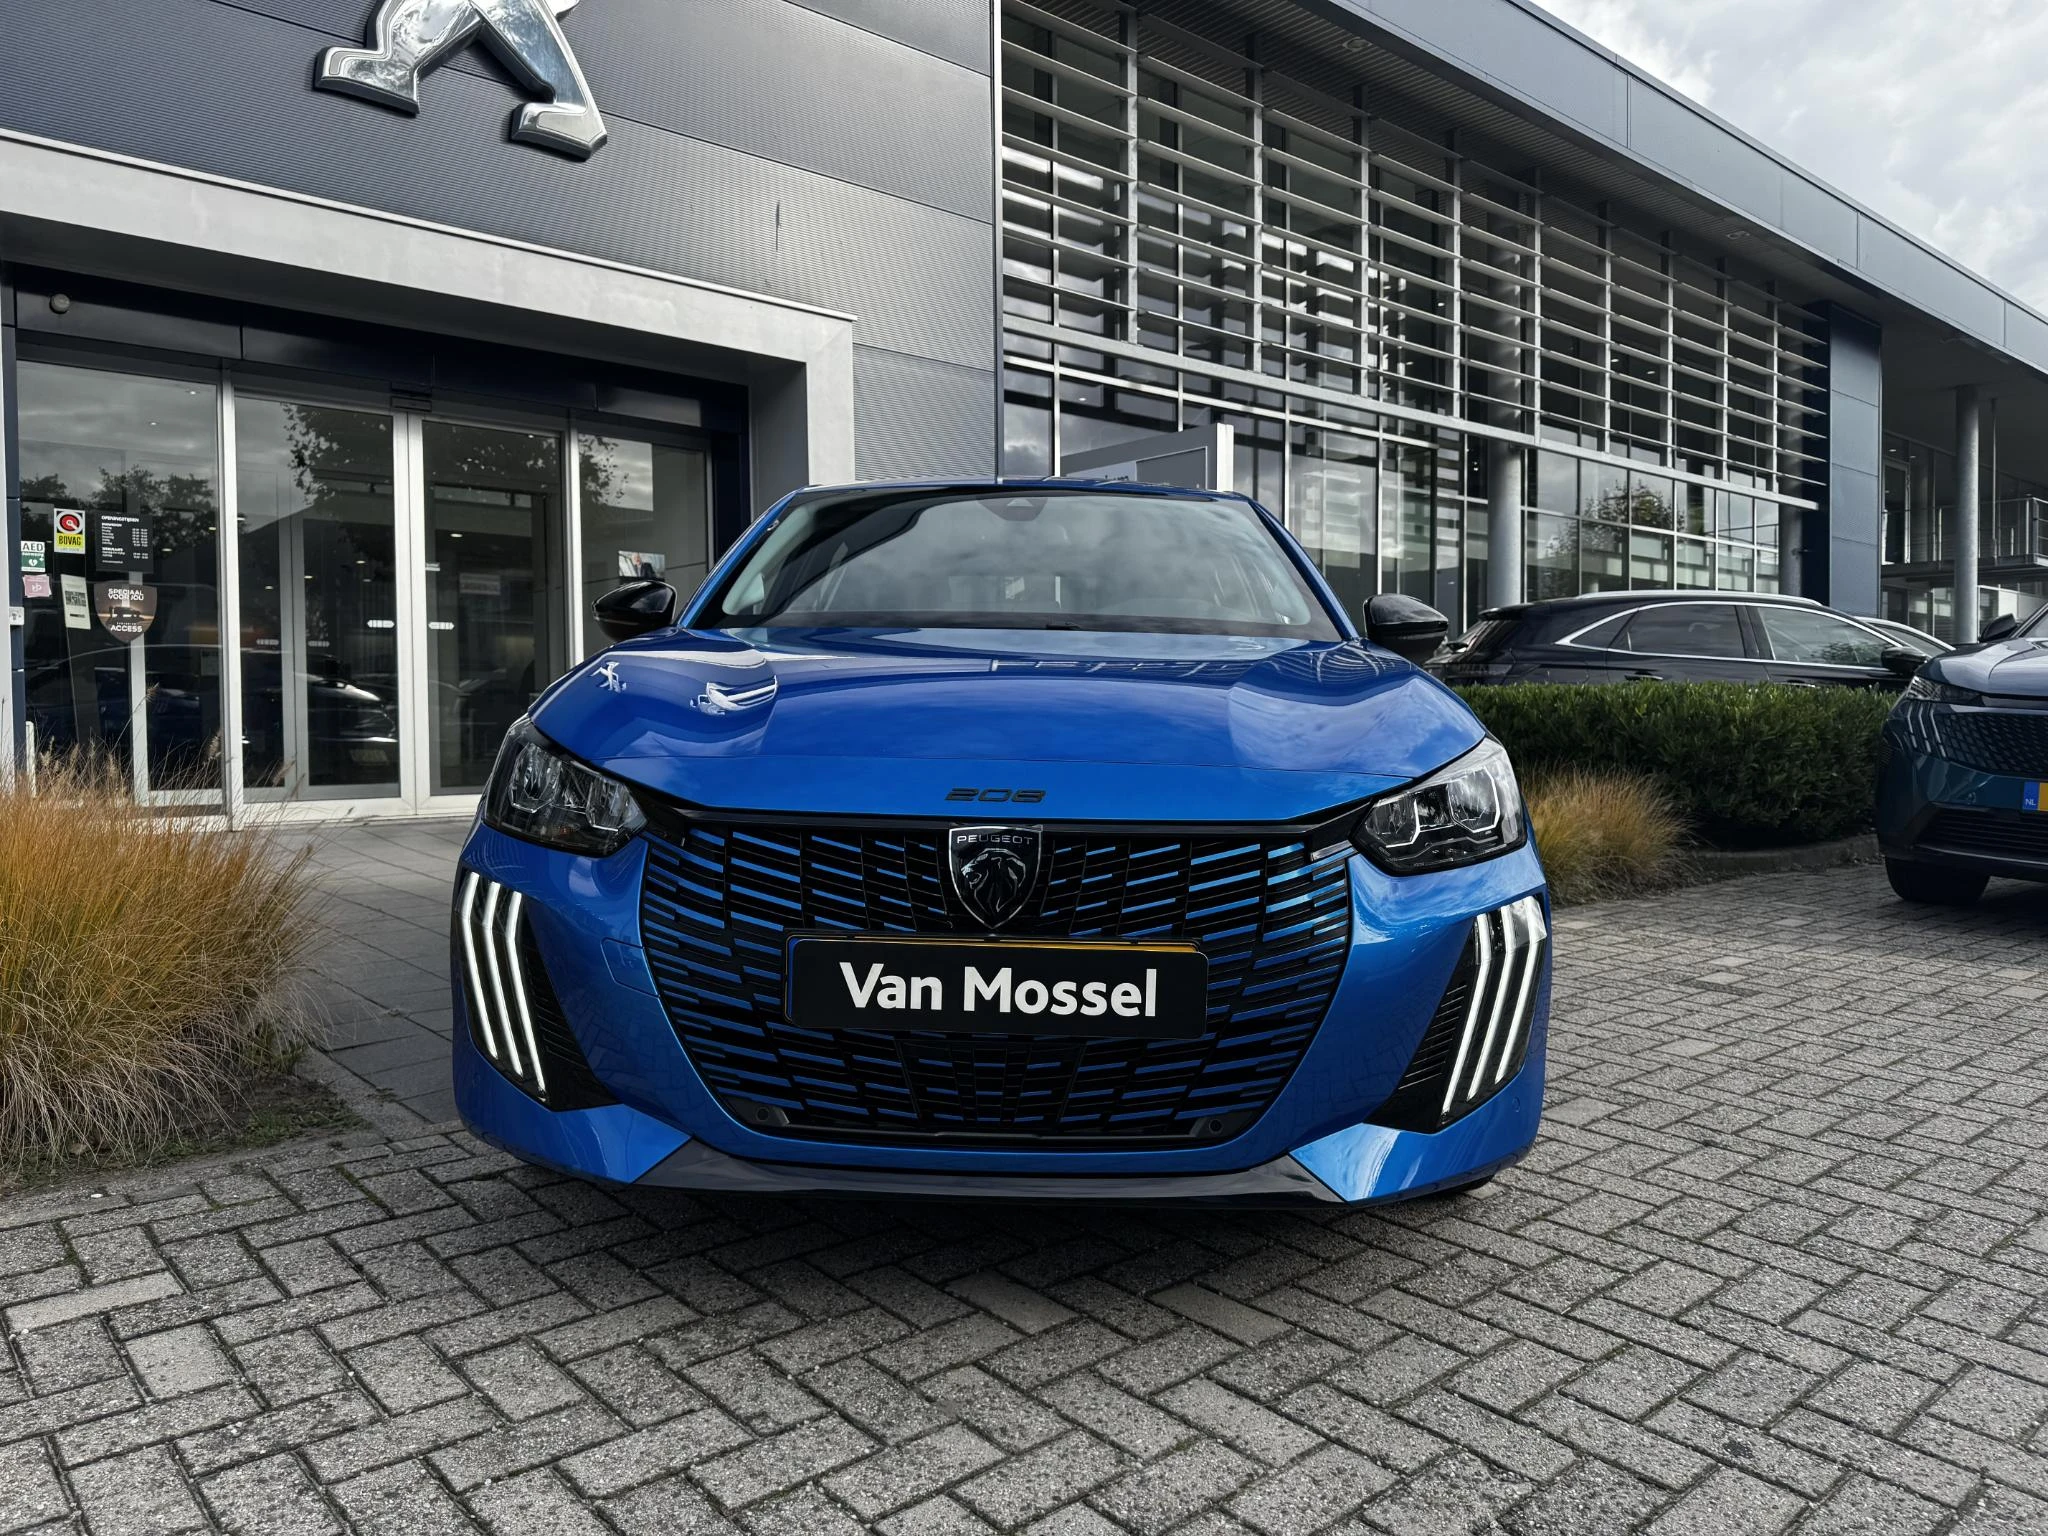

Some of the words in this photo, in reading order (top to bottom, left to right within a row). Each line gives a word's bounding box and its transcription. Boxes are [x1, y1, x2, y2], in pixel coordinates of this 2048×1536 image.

[58, 535, 82, 546] BOVAG
[22, 542, 44, 552] AED
[108, 588, 143, 596] SPECIAAL
[110, 625, 143, 633] ACCESS
[944, 787, 1046, 803] 208
[2025, 798, 2036, 806] NL
[956, 834, 1032, 846] PEUGEOT
[839, 961, 943, 1011] Van
[963, 966, 1157, 1018] Mossel
